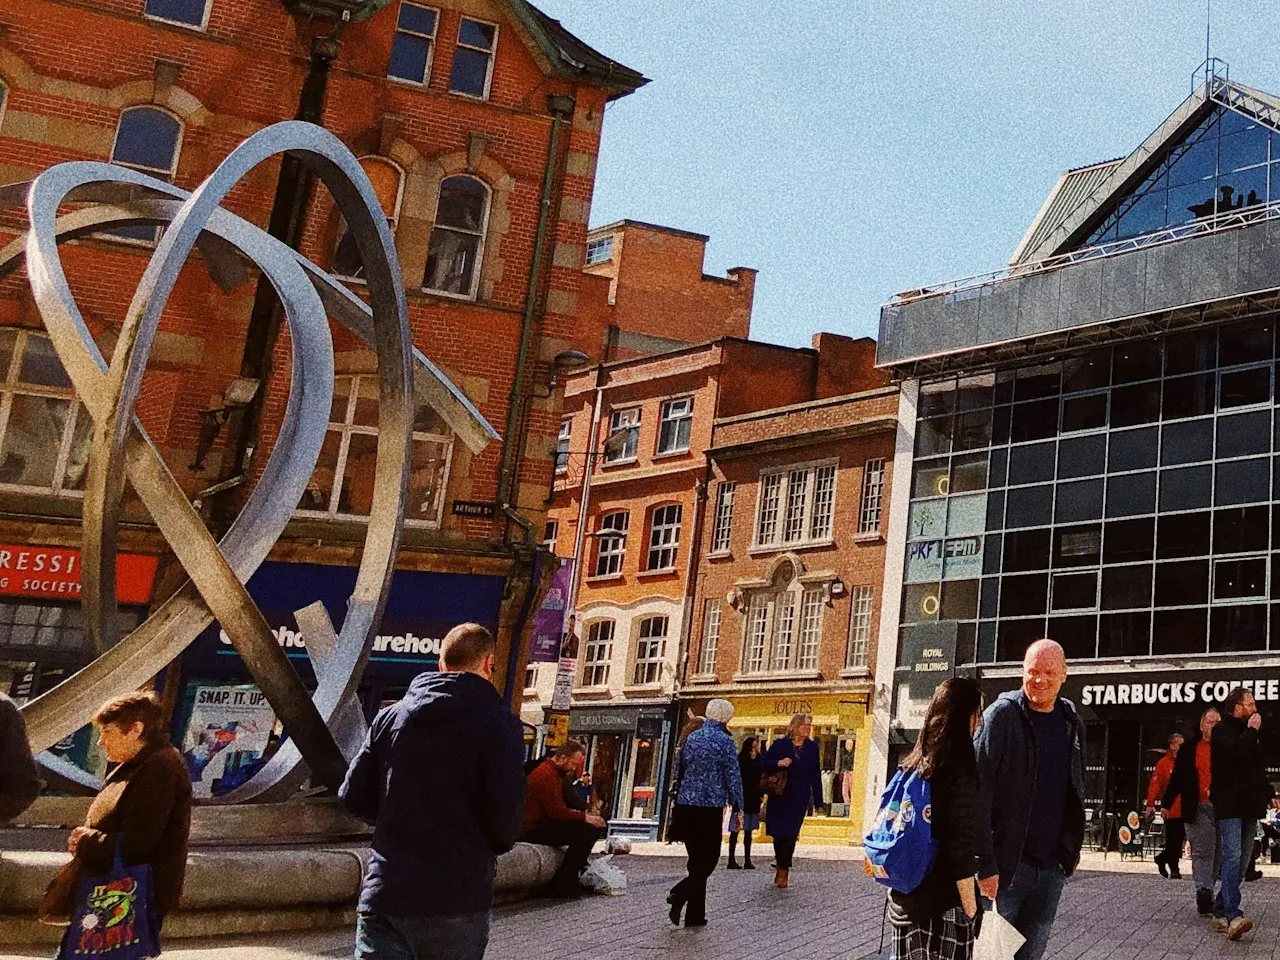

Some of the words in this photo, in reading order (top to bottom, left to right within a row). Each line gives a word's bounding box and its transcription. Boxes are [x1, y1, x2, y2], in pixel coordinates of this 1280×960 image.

[0, 550, 75, 574] RESSI
[22, 579, 82, 593] SOCIETY
[922, 648, 945, 658] ROYAL
[915, 662, 949, 672] BUILDINGS
[1081, 681, 1197, 706] STARBUCKS
[772, 700, 813, 715] JOULES
